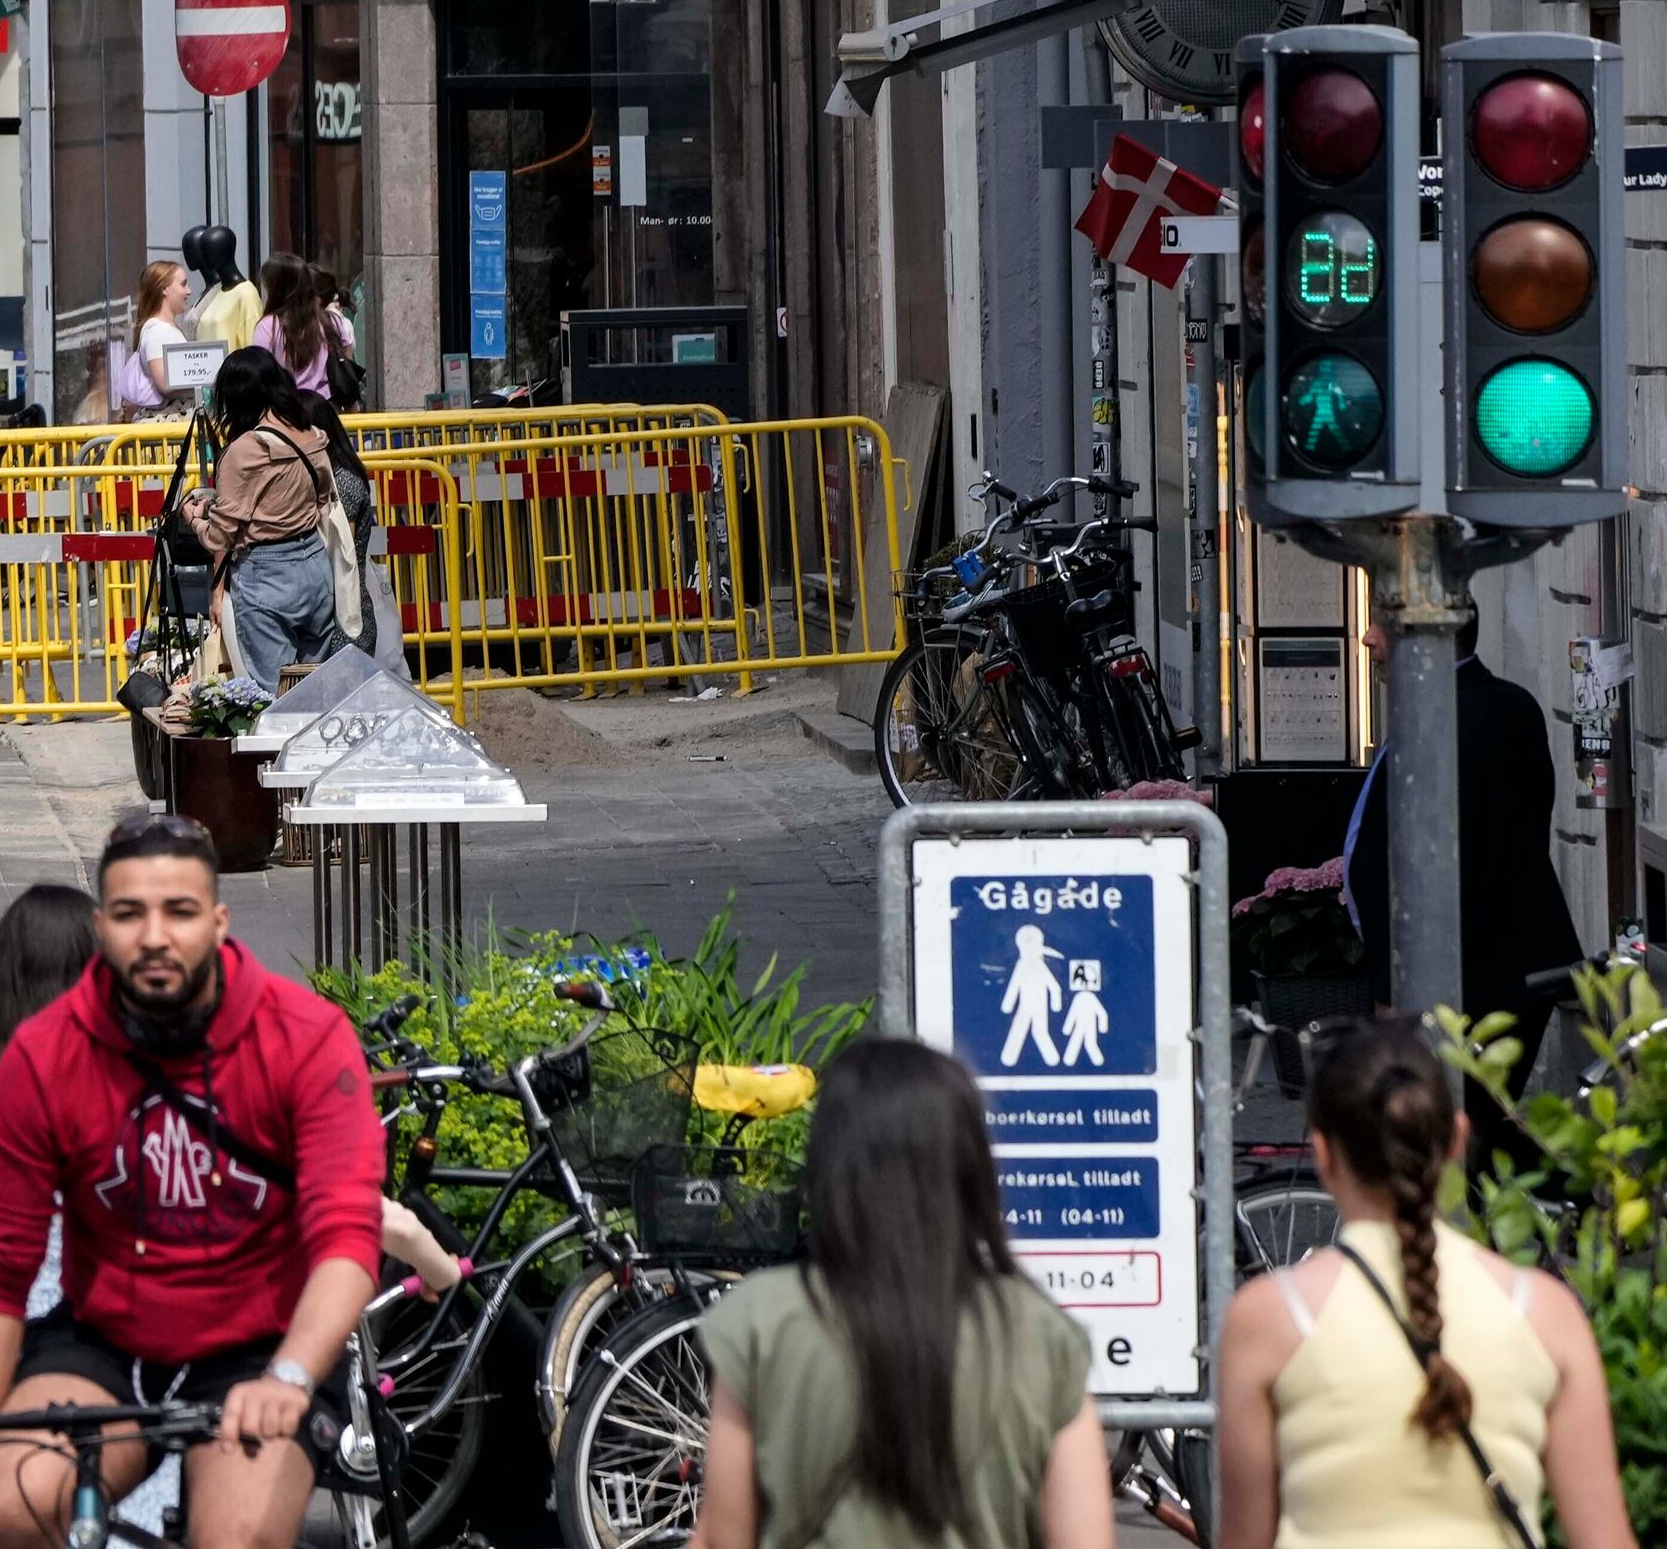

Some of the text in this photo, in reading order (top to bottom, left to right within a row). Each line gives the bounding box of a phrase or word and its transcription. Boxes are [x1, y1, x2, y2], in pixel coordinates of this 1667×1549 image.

[1639, 172, 1667, 189] Lady
[1093, 1108, 1152, 1126] tilladt
[1083, 1169, 1142, 1187] tilladt
[1000, 1206, 1126, 1226] 4-11 (04-11)
[1047, 1271, 1115, 1290] 11-04
